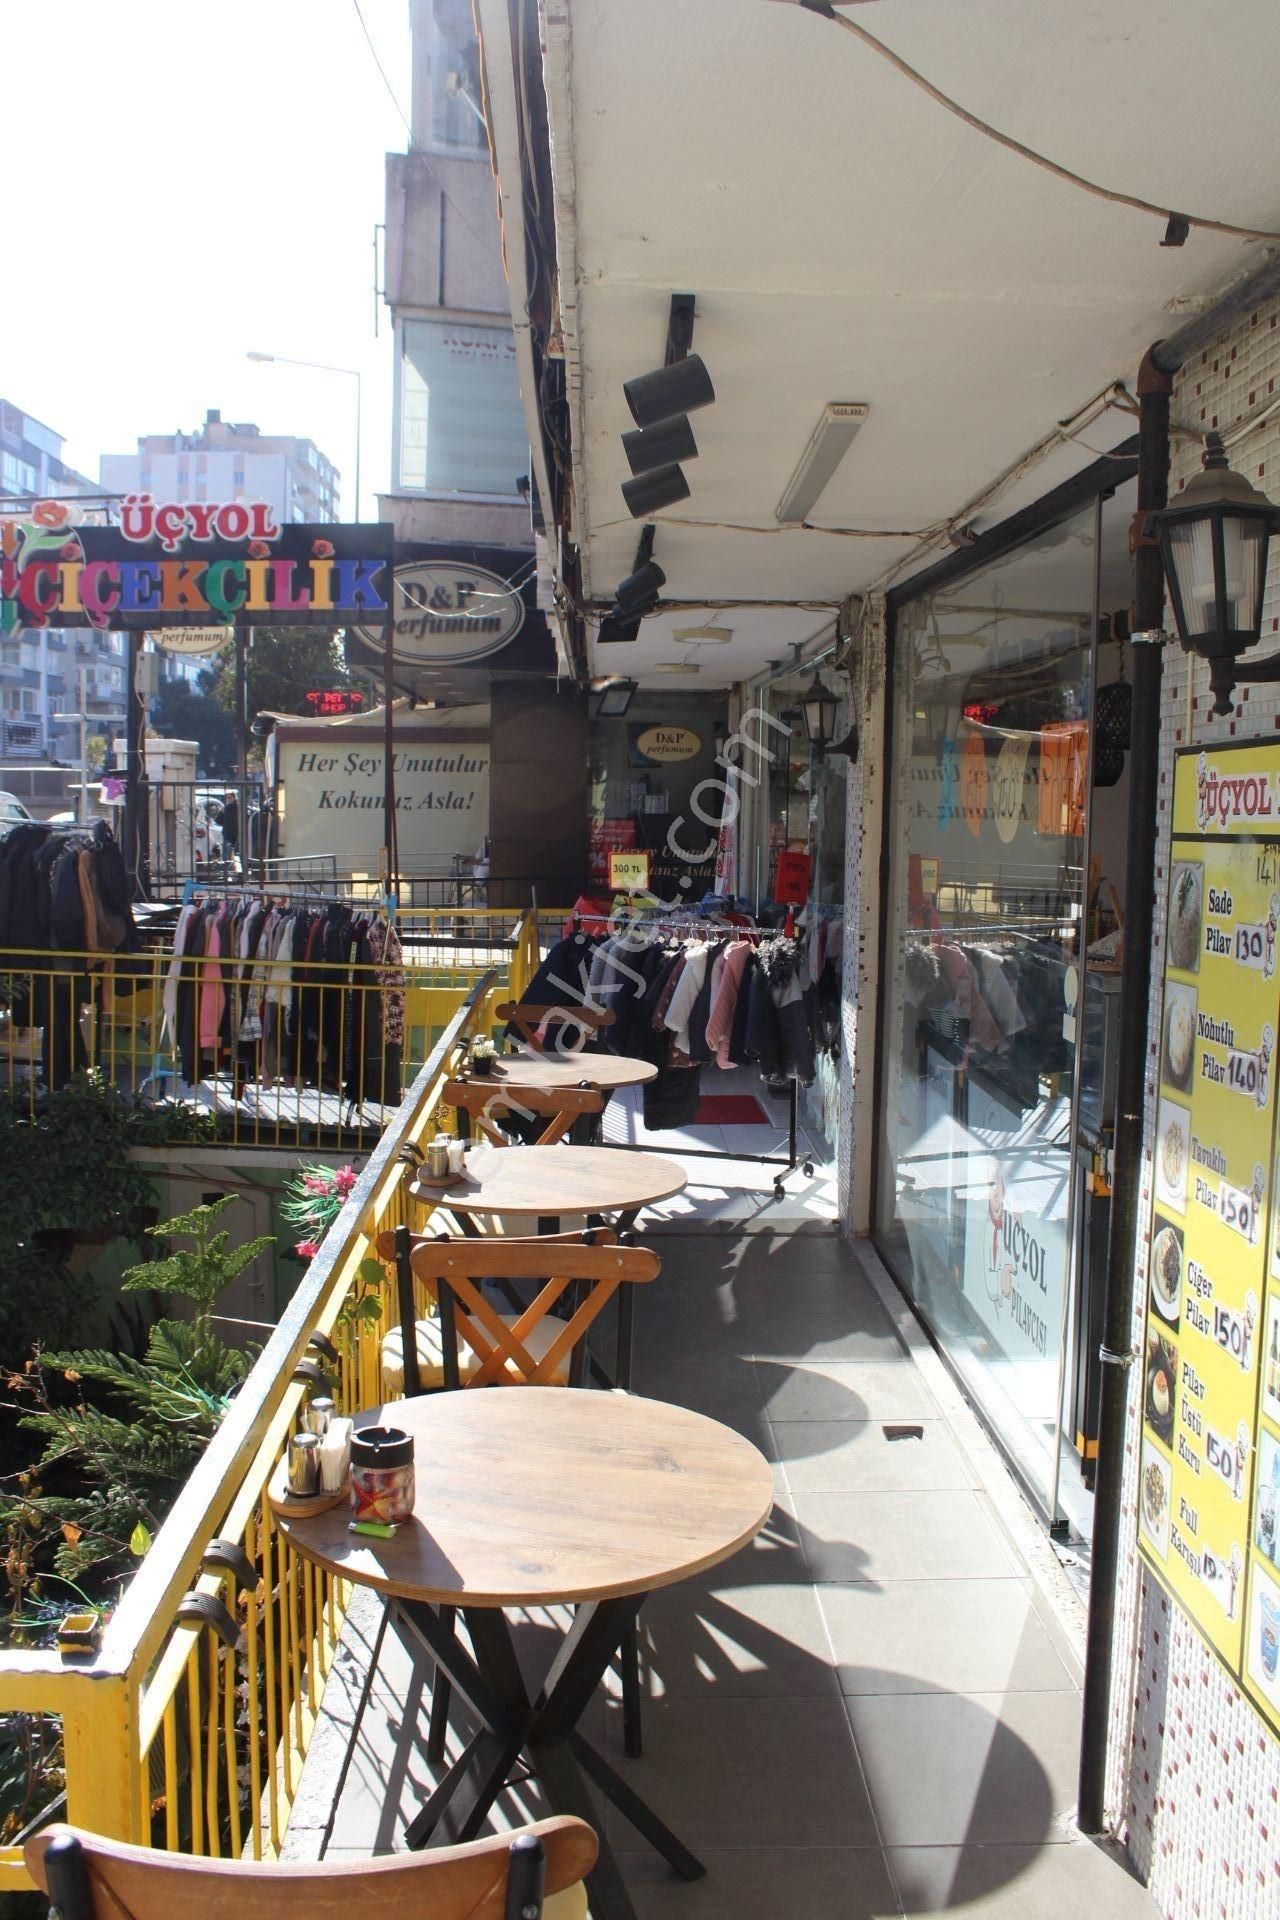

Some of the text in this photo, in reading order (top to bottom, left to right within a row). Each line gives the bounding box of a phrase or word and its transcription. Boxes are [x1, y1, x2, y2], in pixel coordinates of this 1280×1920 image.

[120, 494, 279, 550] ÜÇYOL
[402, 581, 475, 609] D&P
[161, 632, 223, 645] perfumum
[381, 615, 501, 641] erfumum
[647, 744, 693, 755] perfumum
[656, 732, 684, 744] D&P
[298, 753, 338, 772] Her
[344, 753, 381, 777] Şey
[417, 791, 474, 810] Asla!
[1205, 770, 1272, 826] ÜÇYOL
[613, 864, 629, 873] 300
[1208, 888, 1232, 915] Sade
[1206, 927, 1232, 955] Pilav
[1236, 929, 1262, 960] 130
[1198, 1013, 1234, 1047] Nohutlu
[1202, 1054, 1226, 1084] Pilav
[1227, 1054, 1256, 1092] 140
[1191, 1136, 1227, 1177] Tavuklu
[1195, 1177, 1218, 1211] Pilav
[1221, 1186, 1249, 1231] 150
[1187, 1261, 1213, 1298] Ciğer
[1186, 1297, 1210, 1336] Pilav
[1214, 1306, 1240, 1356] 150
[1182, 1362, 1205, 1400] Pilav
[1181, 1393, 1202, 1438] Üstü
[1178, 1433, 1201, 1476] Kuru
[1180, 1496, 1198, 1536] Full
